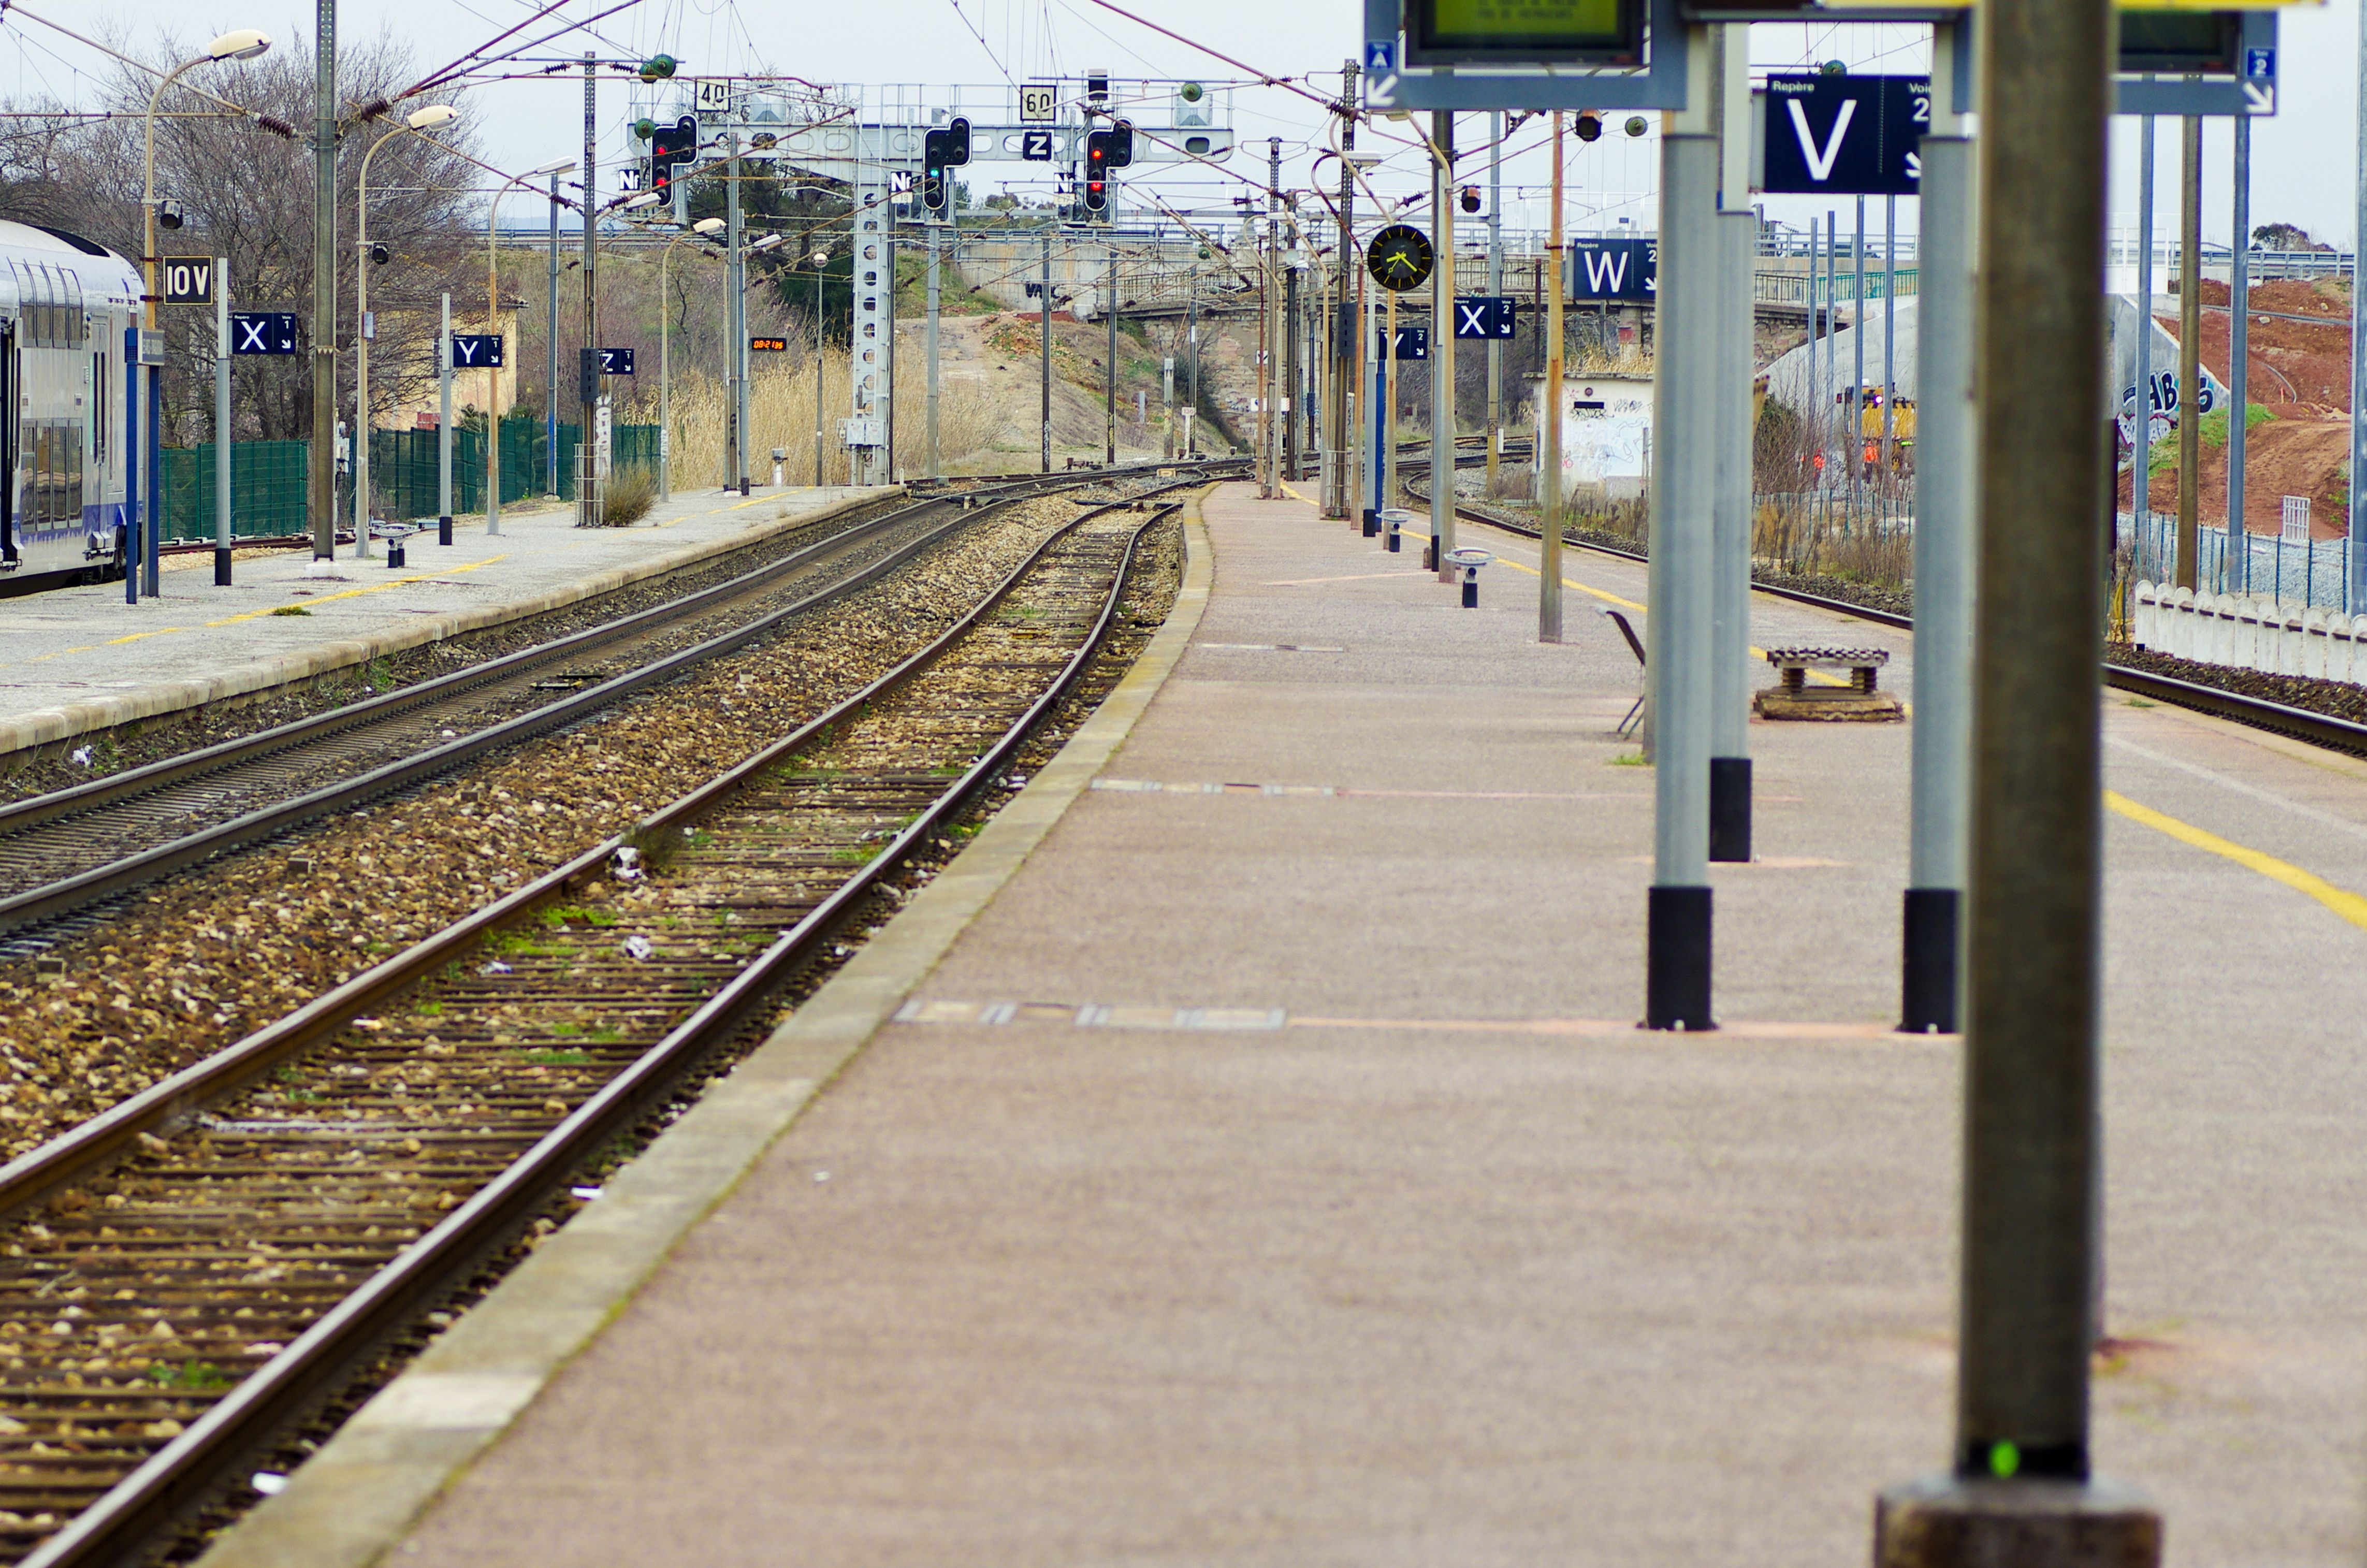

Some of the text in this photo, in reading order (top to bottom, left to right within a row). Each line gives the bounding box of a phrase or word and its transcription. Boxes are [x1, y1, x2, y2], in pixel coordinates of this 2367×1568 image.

[1371, 51, 1387, 67] A
[2255, 59, 2267, 76] 2
[702, 84, 724, 103] 40
[1772, 81, 1814, 93] Repère
[1027, 94, 1050, 112] 60
[1913, 97, 1929, 122] 2
[1030, 136, 1047, 155] Z
[1788, 99, 1857, 180] V
[1648, 250, 1657, 262] 2
[1585, 251, 1628, 293] W
[1503, 305, 1509, 314] 2
[284, 320, 289, 329] 1
[1459, 306, 1486, 335] X
[240, 321, 266, 350] X
[458, 341, 478, 364] Y
[600, 353, 614, 372] Z
